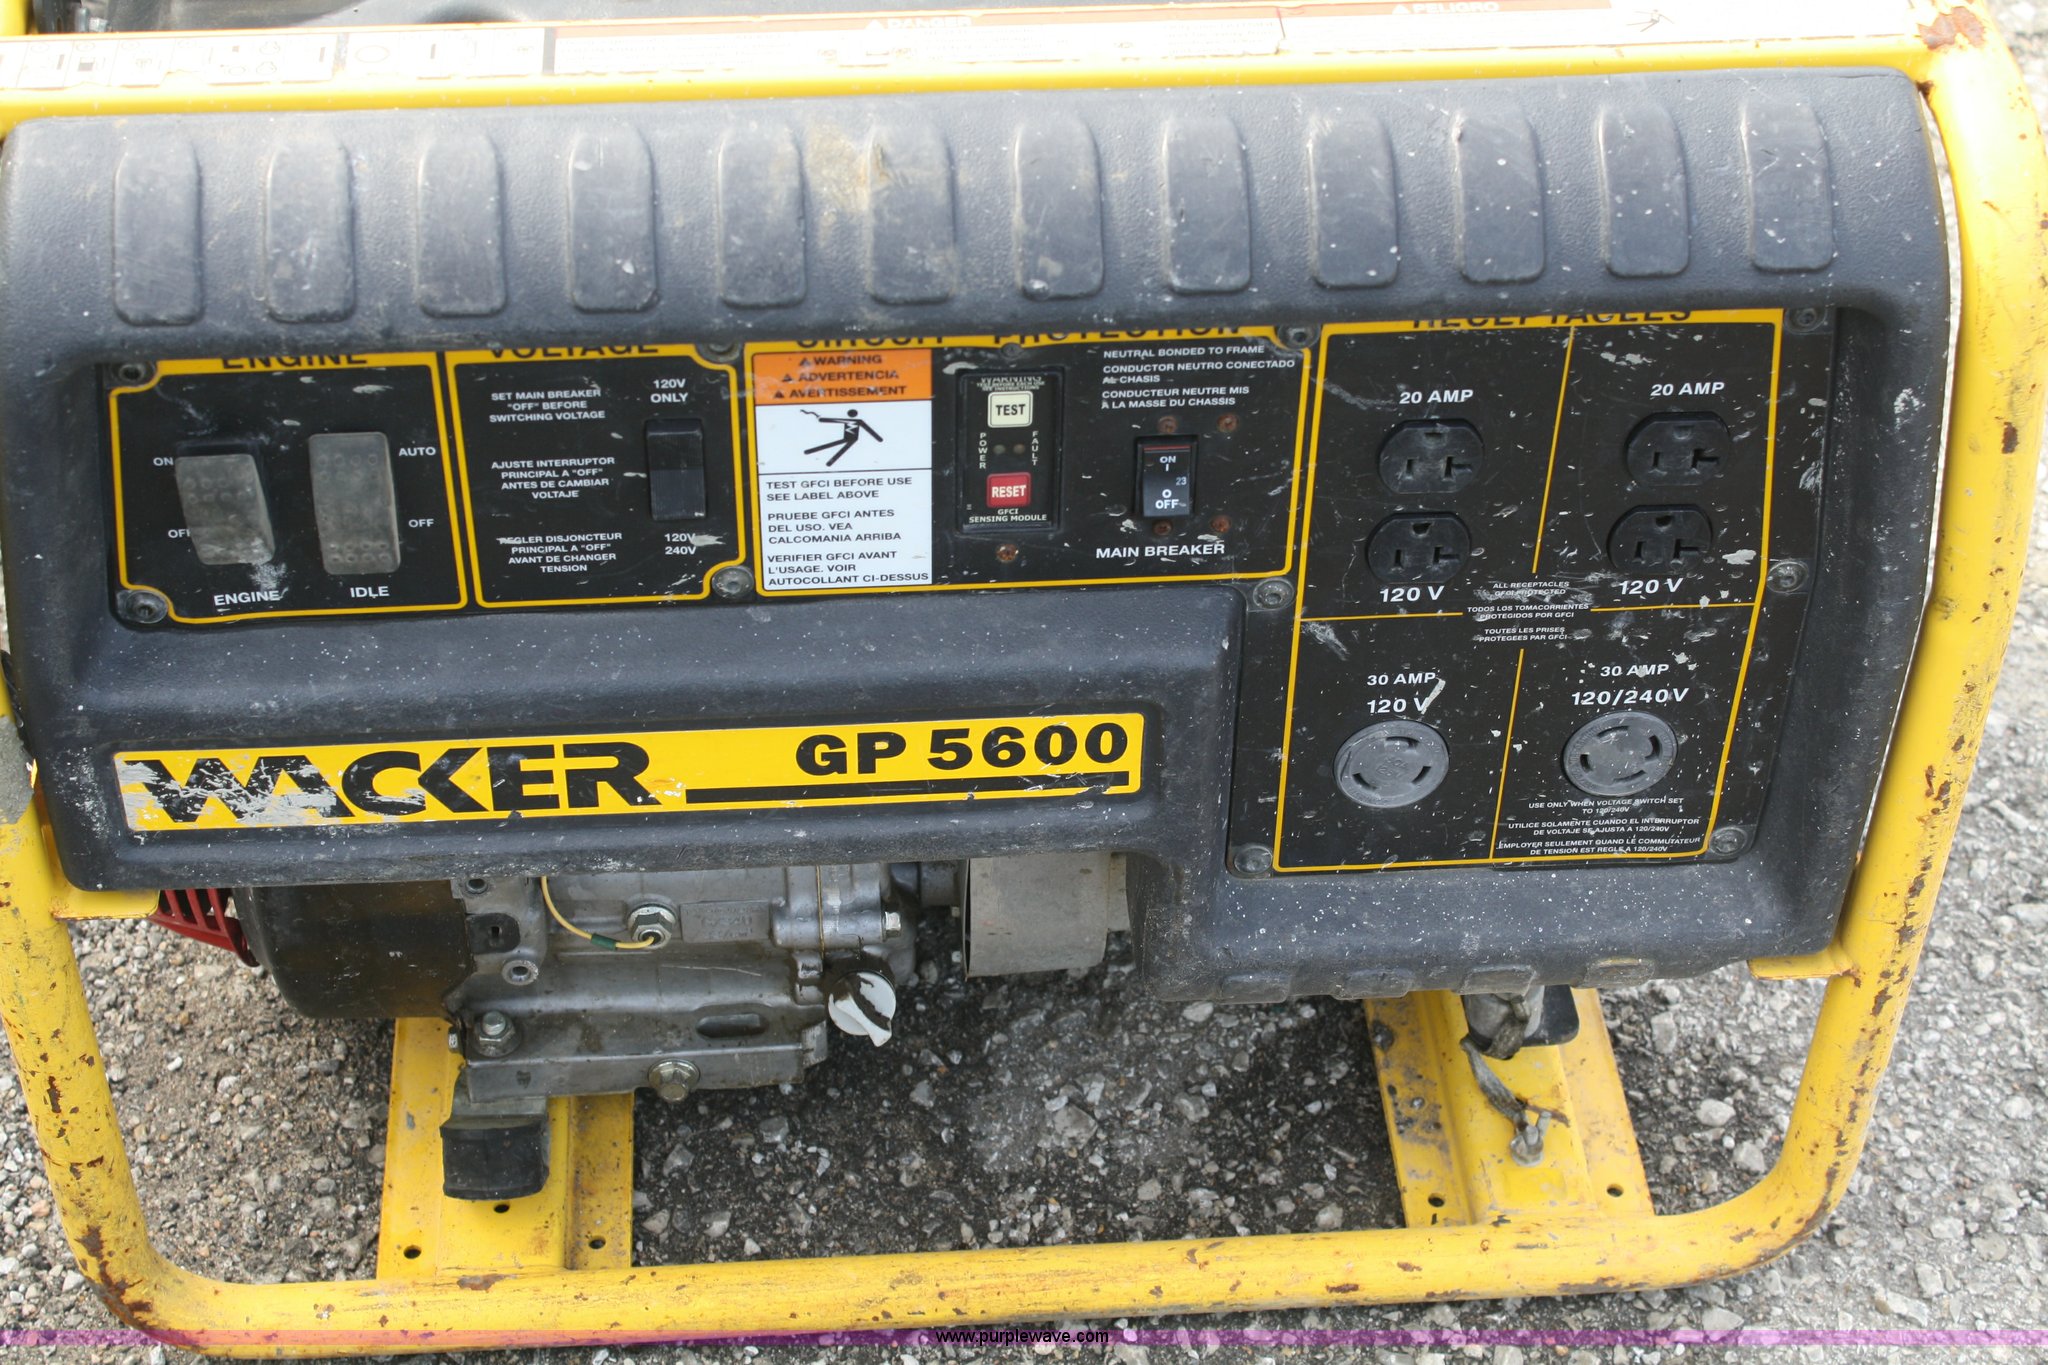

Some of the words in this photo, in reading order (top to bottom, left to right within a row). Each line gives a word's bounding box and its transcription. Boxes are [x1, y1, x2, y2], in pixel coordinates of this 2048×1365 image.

[1413, 2, 1499, 13] PELIGRO
[888, 16, 972, 29] DANGER
[1103, 350, 1155, 359] NEUTRAL
[1158, 348, 1205, 357] BONDED
[1208, 347, 1224, 355] TO
[1226, 345, 1265, 354] FRAME
[815, 354, 882, 366] WARNING
[1103, 363, 1174, 373] CONDUCTOR
[1177, 362, 1223, 371] NEUTRO
[1226, 360, 1295, 369] CONECTADO
[798, 370, 899, 382] ADVERTENCIA
[1119, 375, 1160, 383] CHASIS
[653, 378, 686, 389] 120V
[1650, 384, 1674, 396] 20
[1678, 382, 1725, 395] AMP
[491, 392, 512, 401] SET
[515, 391, 545, 400] MAIN
[547, 389, 601, 399] BREAKER
[789, 385, 907, 398] AVERTISSEMENT
[1102, 388, 1180, 399] CONDUCTEUR
[1182, 387, 1226, 396] NEUTRE
[1229, 386, 1250, 395] MIS
[1399, 391, 1422, 404] 20
[1427, 389, 1474, 403] AMP
[650, 393, 689, 403] ONLY
[1112, 401, 1126, 409] LA
[1129, 399, 1166, 408] MASSE
[1169, 398, 1185, 407] DU
[1188, 397, 1235, 406] CHASSIS
[507, 402, 539, 411] "OFF"
[542, 401, 587, 410] BEFORE
[996, 404, 1026, 416] TEST
[489, 413, 553, 423] SWITCHING
[555, 411, 606, 420] VOLTAGE
[399, 446, 436, 457] AUTO
[978, 432, 988, 469] POWER
[1031, 430, 1039, 466] FAULT
[153, 457, 174, 467] ON
[491, 460, 534, 469] AJUSTE
[536, 457, 615, 468] INTERRUPTOR
[501, 470, 559, 479] PRINCIPAL
[562, 469, 570, 477] A
[572, 468, 603, 477] "OFF"
[501, 481, 538, 490] ANTES
[540, 480, 556, 489] DE
[558, 478, 609, 488] CAMBIAR
[766, 481, 797, 489] TEST
[801, 480, 830, 488] GFCI
[834, 478, 884, 487] BEFORE
[888, 477, 912, 485] USE
[1176, 477, 1187, 486] 23
[532, 490, 579, 499] VOLTAJE
[767, 493, 790, 501] SEE
[794, 492, 833, 500] LABEL
[837, 490, 880, 499] ABOVE
[991, 484, 1027, 498] RESET
[1155, 499, 1179, 510] OFF
[768, 512, 818, 521] PRUEBE
[822, 511, 850, 519] GFCI
[854, 509, 895, 518] ANTES
[969, 516, 1008, 524] SENSING
[408, 519, 434, 528] OFF
[768, 524, 792, 533] DEL
[796, 523, 825, 532] USO.
[829, 522, 853, 531] VEA
[546, 533, 622, 543] DISJONCTEUR
[664, 533, 696, 542] 120V
[769, 534, 852, 544] CALCOMANIA
[855, 532, 902, 541] ARRIBA
[511, 545, 568, 554] PRINCIPAL
[581, 543, 611, 551] "OFF"
[665, 546, 697, 555] 240V
[1096, 547, 1139, 559] MAIN
[1144, 543, 1225, 557] BREAKER
[508, 556, 542, 564] AVANT
[546, 555, 560, 563] DE
[563, 553, 616, 562] CHANGER
[767, 553, 822, 563] VERIFIER
[826, 553, 855, 561] GFCI
[858, 551, 897, 560] AVANT
[540, 564, 588, 573] TENSION
[768, 565, 823, 575] L'USAGE.
[827, 564, 856, 573] VOIR
[768, 575, 859, 586] AUTOCOLLANT
[862, 573, 929, 583] CI-DESSUS
[350, 586, 390, 598] IDLE
[1619, 579, 1659, 595] 120
[1666, 577, 1684, 593] V
[214, 590, 280, 606] ENGINE
[1379, 587, 1420, 602] 120
[1427, 585, 1445, 600] V
[1600, 666, 1622, 677] 30
[1627, 664, 1670, 676] AMP
[1367, 675, 1389, 686] 30
[1393, 672, 1436, 685] AMP
[1367, 699, 1407, 714] 120
[1414, 697, 1431, 712] V
[796, 731, 907, 776] GP
[927, 722, 1128, 770] 5600
[125, 741, 662, 823] WACKER
[1541, 820, 1591, 828] SOLAMENTE
[1499, 841, 1543, 849] EMPLOYER
